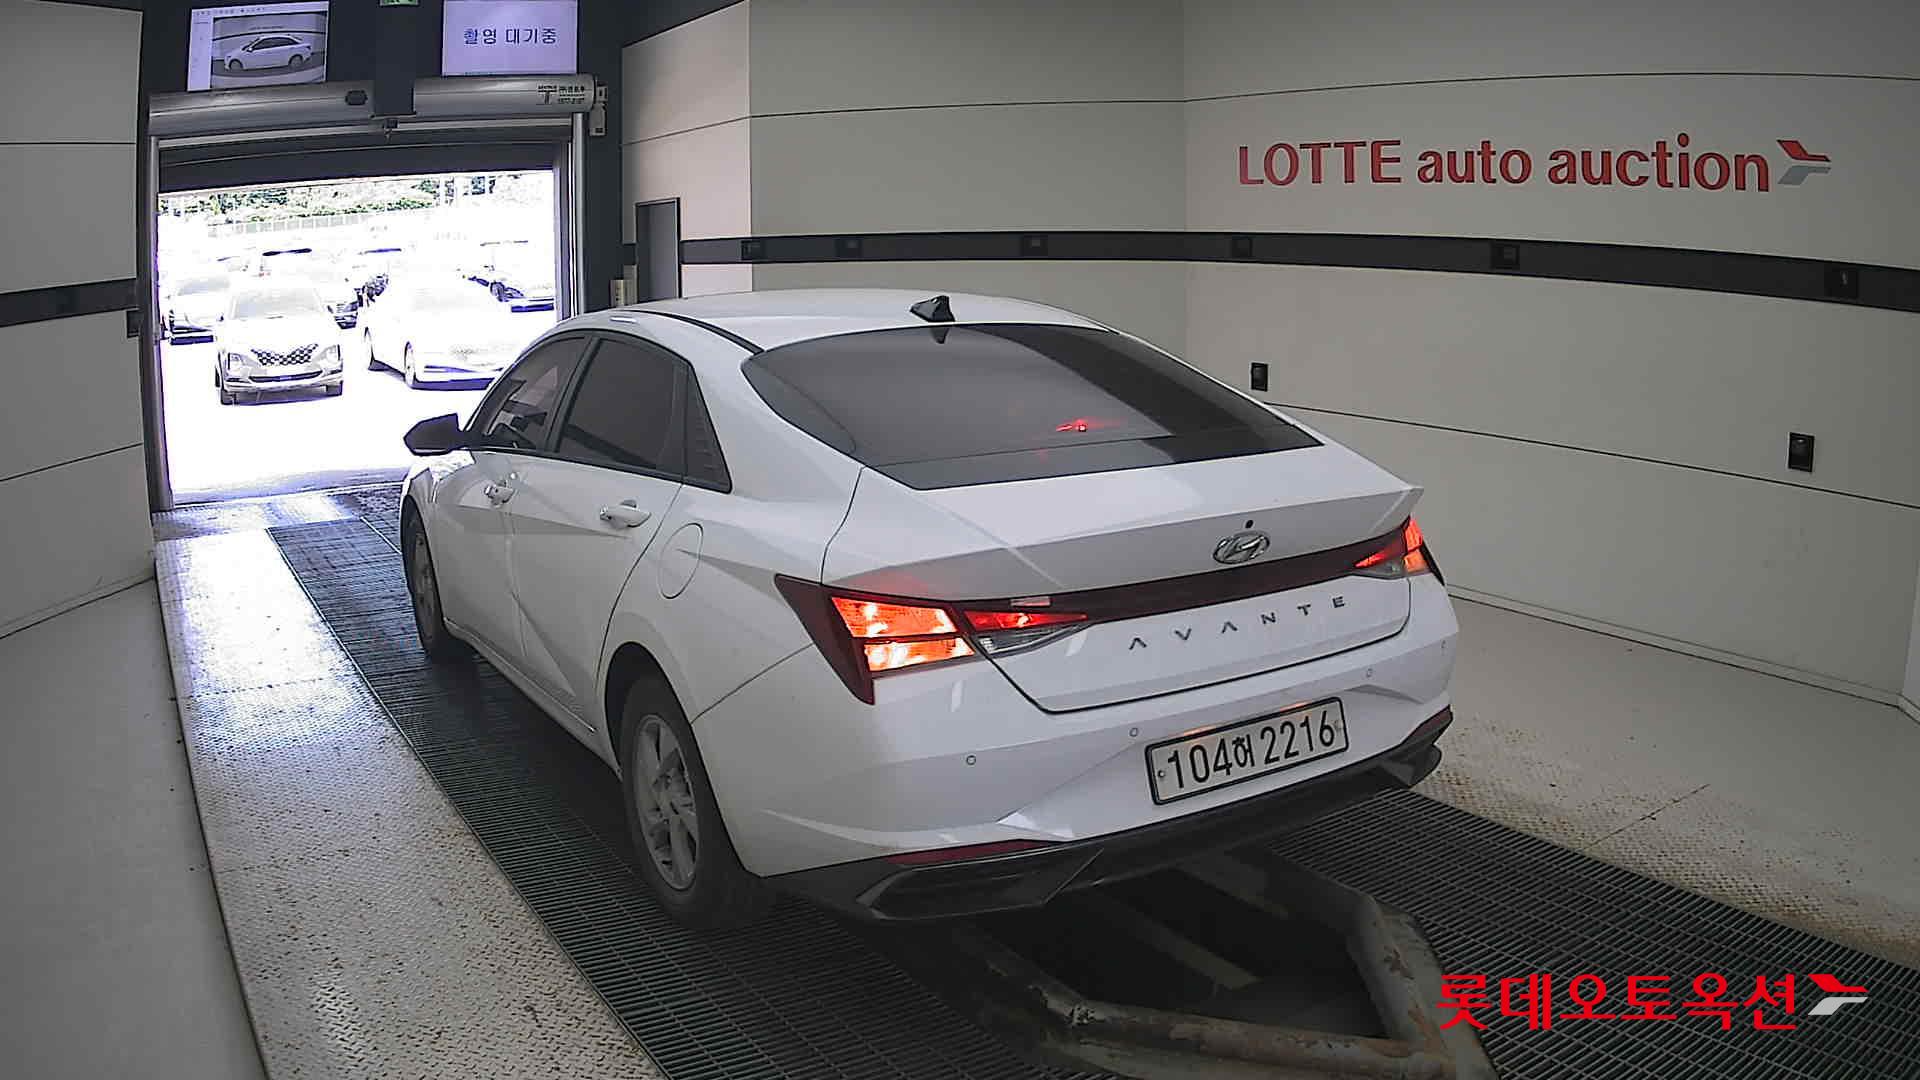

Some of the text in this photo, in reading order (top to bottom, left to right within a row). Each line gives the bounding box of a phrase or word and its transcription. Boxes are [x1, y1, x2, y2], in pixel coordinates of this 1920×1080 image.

[505, 28, 557, 45] 대기중
[1239, 132, 1769, 192] LOTTE auto auction
[1128, 596, 1345, 651] AVANTE
[1167, 710, 1335, 788] 104허 2216
